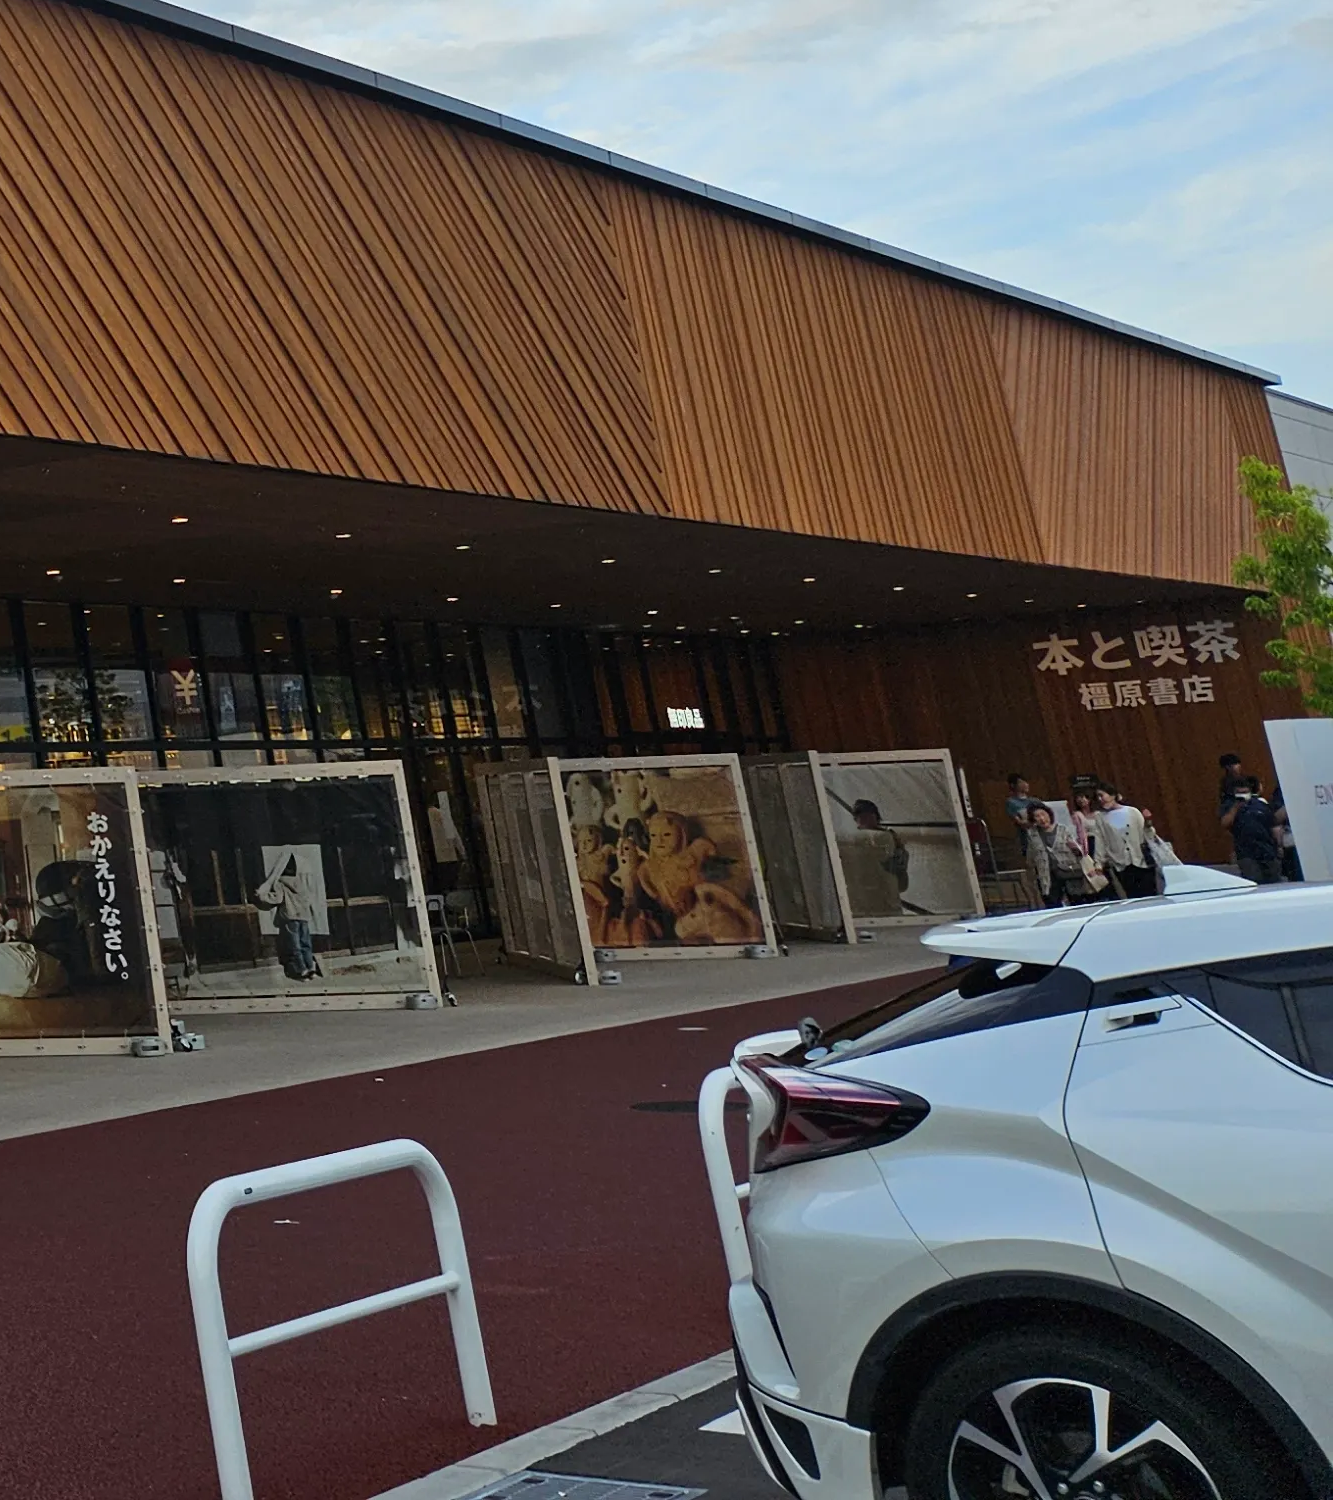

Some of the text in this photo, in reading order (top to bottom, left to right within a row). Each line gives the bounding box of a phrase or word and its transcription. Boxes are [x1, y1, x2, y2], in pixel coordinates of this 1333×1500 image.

[1032, 619, 1241, 676] 本と喫茶
[1078, 674, 1215, 711] 橿原書店
[666, 705, 705, 729] 無印良品
[86, 811, 129, 980] おかえりなさい。
